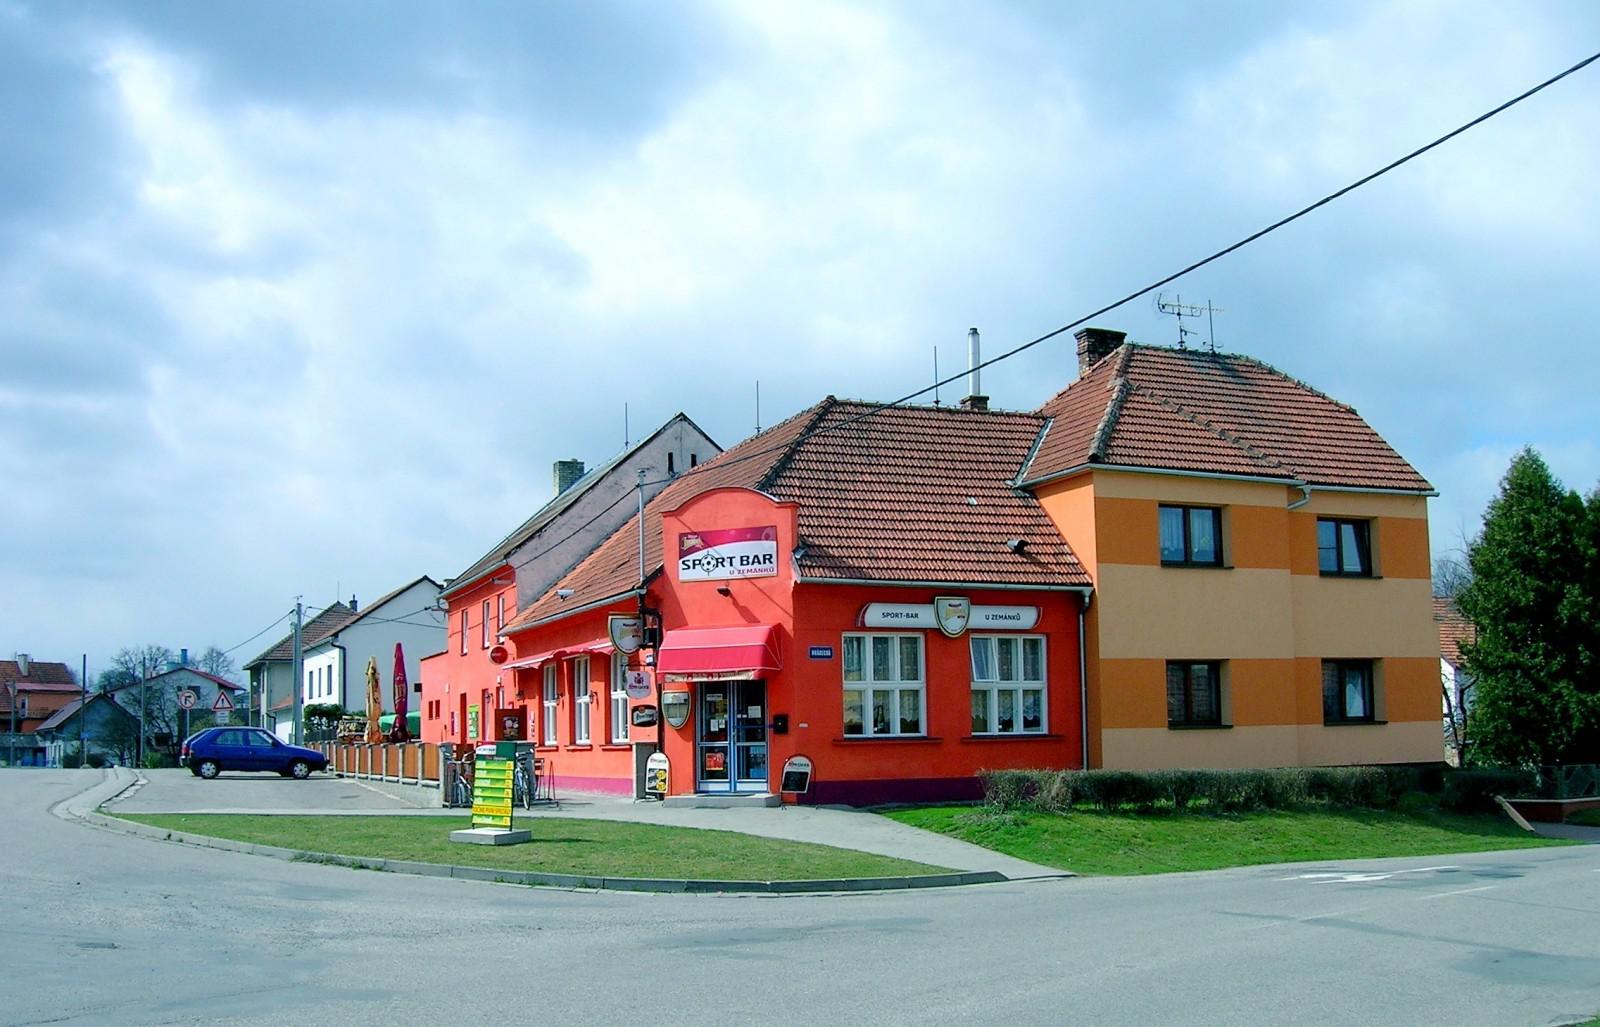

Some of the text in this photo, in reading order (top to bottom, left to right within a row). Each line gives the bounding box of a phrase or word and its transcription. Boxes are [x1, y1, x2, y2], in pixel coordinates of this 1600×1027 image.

[682, 554, 773, 572] SPORT BAR
[991, 612, 1021, 621] ZEMÁNKŮ
